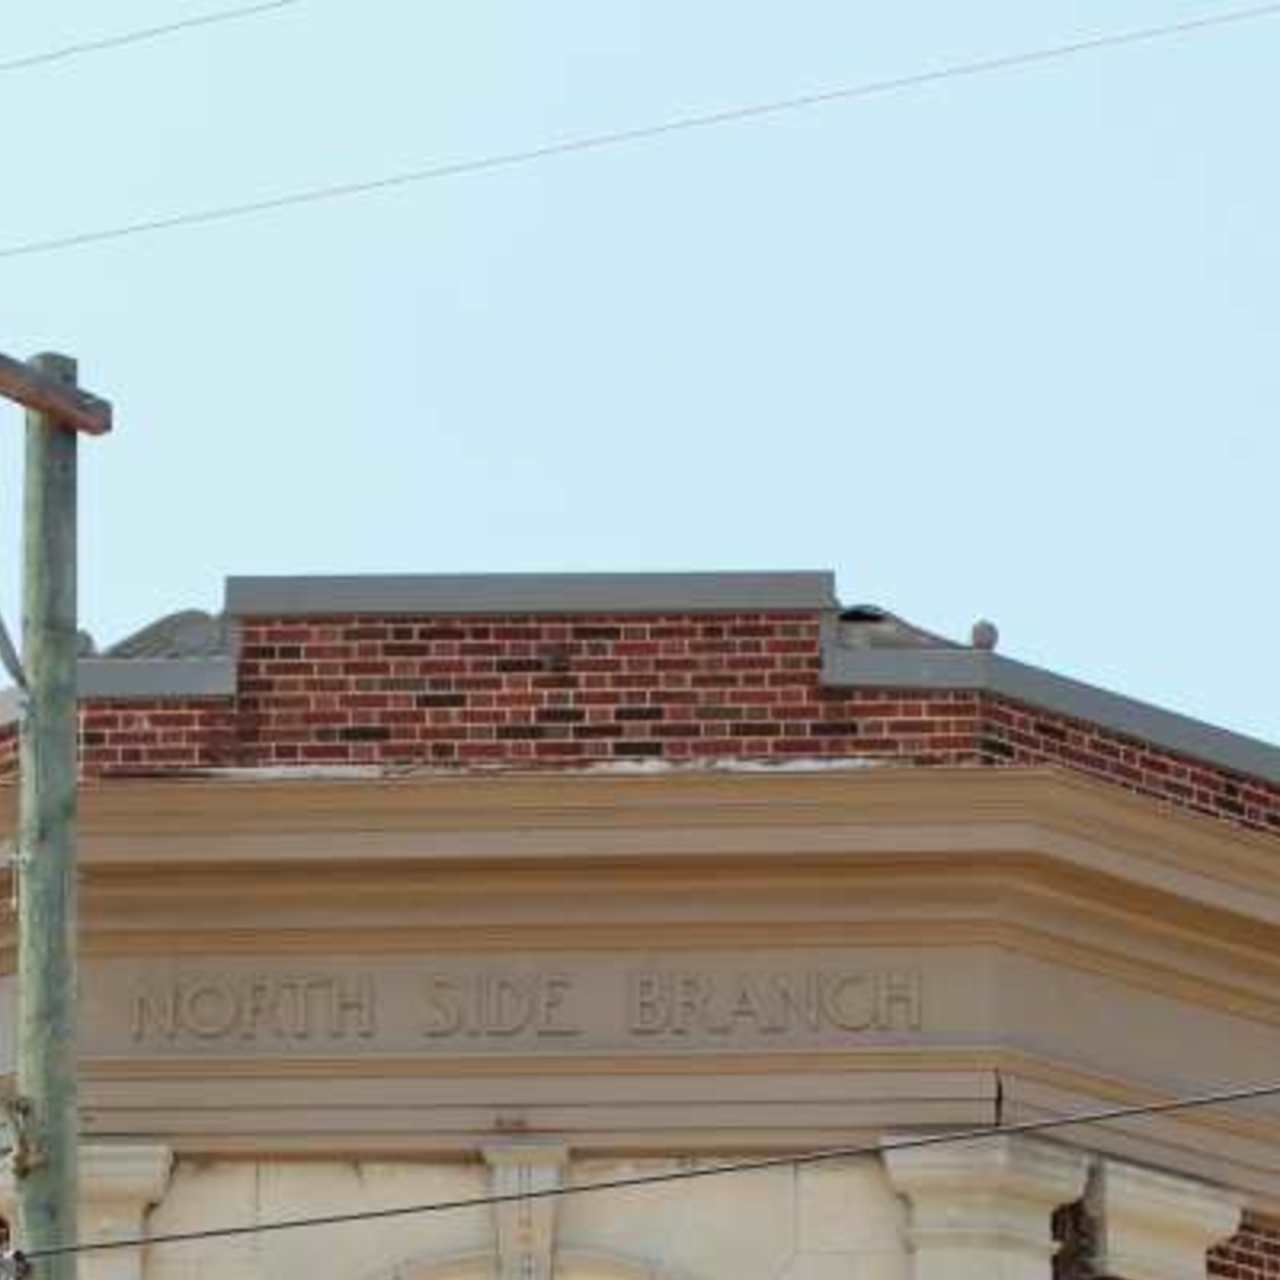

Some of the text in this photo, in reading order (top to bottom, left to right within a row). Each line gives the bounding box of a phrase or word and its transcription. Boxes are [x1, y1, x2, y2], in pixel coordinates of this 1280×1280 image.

[130, 967, 925, 1041] NORTH SIDE BRANCH
